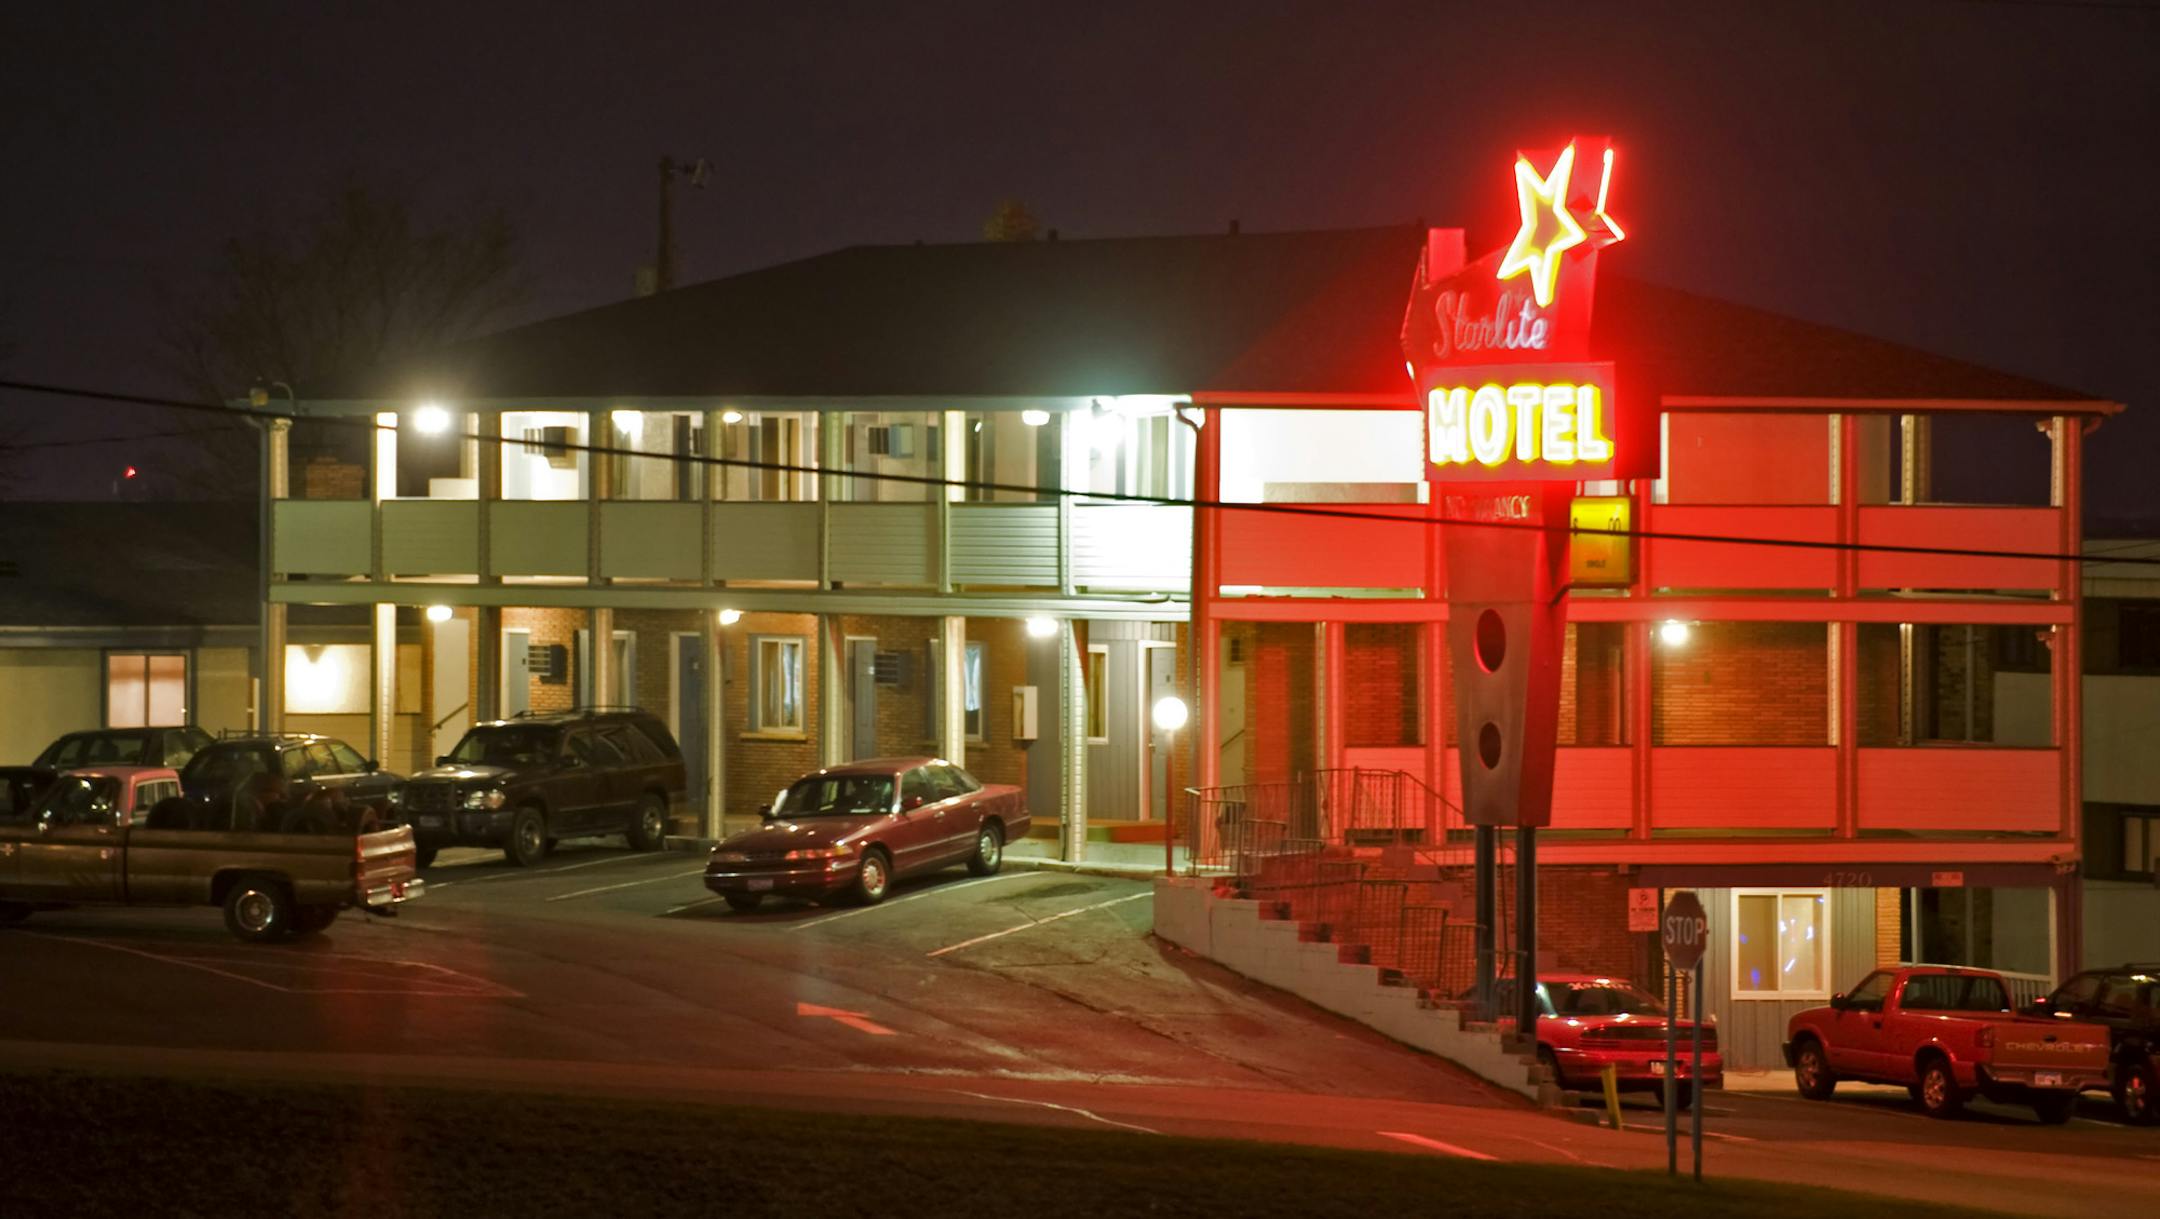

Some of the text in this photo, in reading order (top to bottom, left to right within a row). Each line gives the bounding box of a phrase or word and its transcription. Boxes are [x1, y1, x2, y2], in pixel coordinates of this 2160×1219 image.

[1432, 290, 1548, 358] Starlite
[1428, 383, 1614, 466] MOTEL
[1823, 871, 1873, 888] 4720
[1665, 915, 1706, 945] STOP
[2005, 1041, 2095, 1054] CHEVROLET
